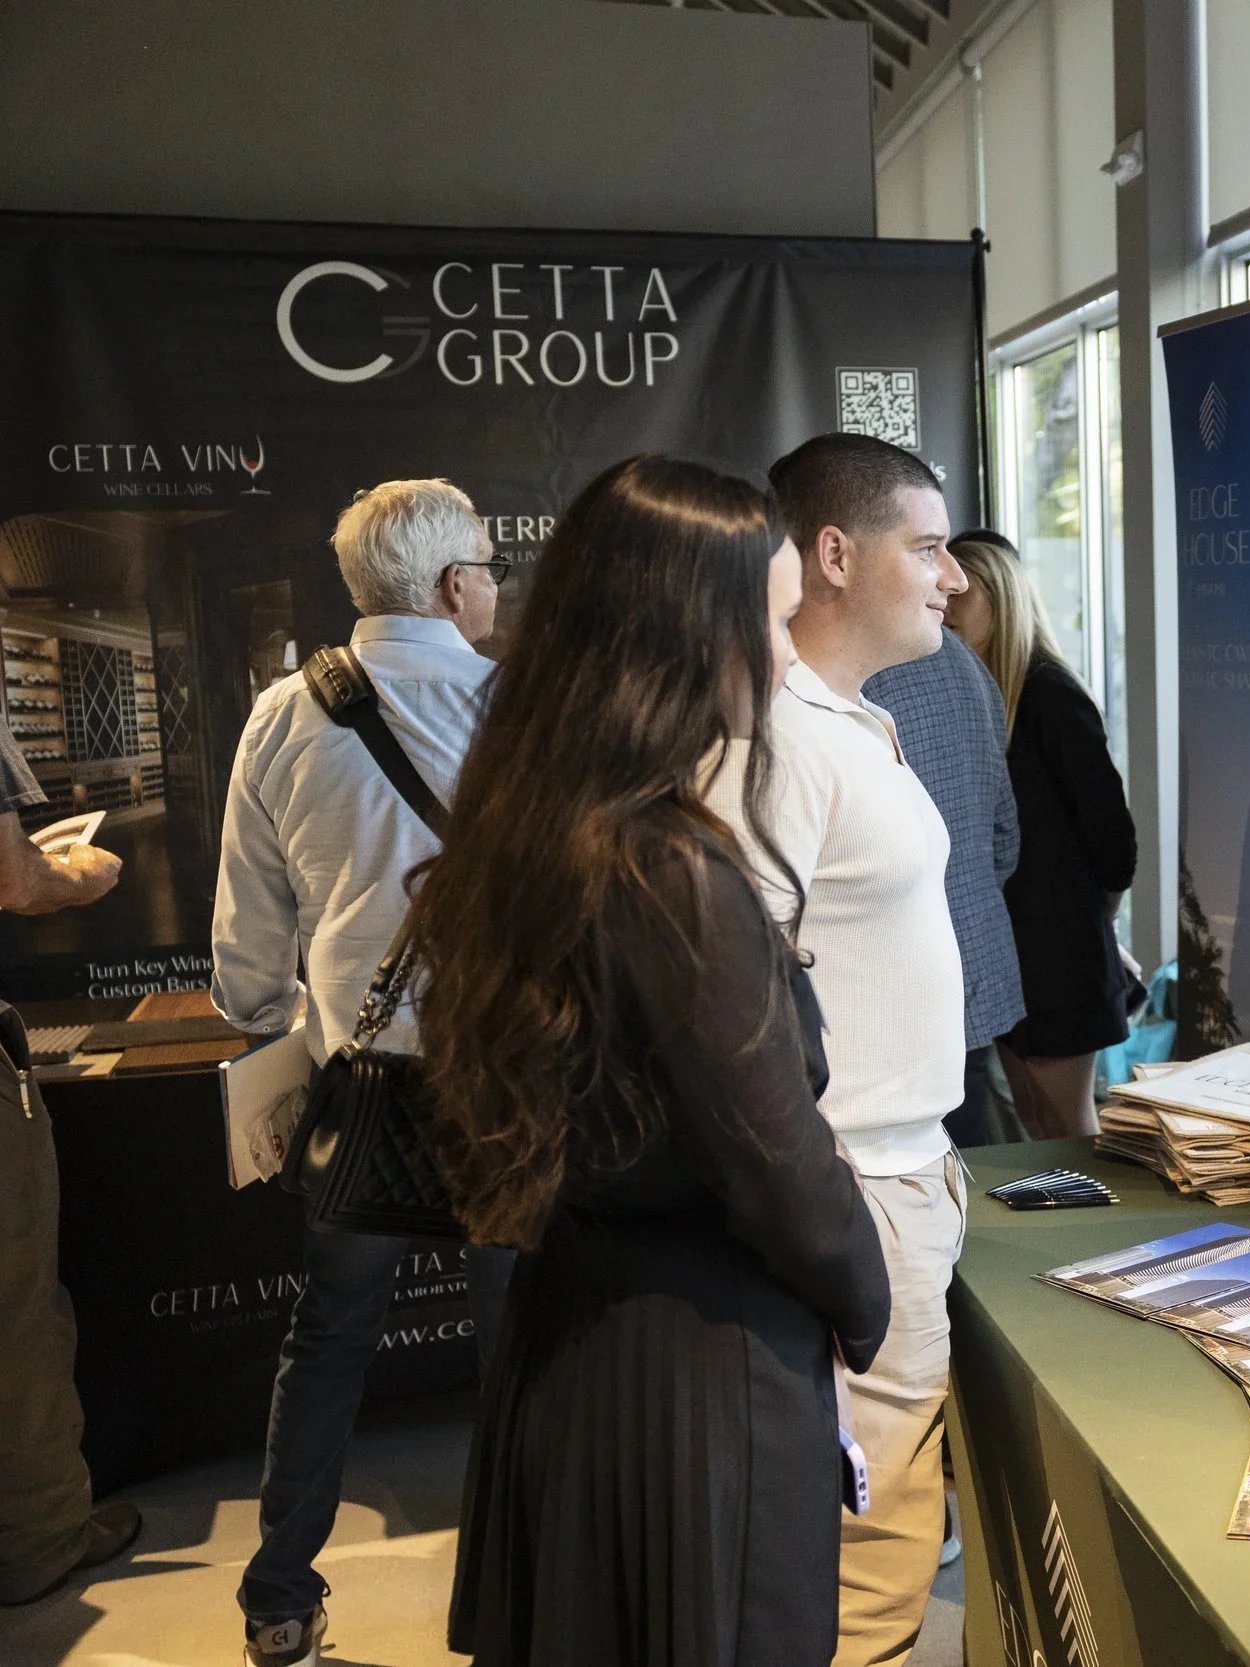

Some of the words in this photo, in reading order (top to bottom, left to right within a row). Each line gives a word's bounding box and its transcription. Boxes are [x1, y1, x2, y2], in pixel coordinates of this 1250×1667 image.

[433, 262, 677, 322] CETTA
[437, 329, 679, 386] GROUP
[48, 444, 161, 473] CETTA
[103, 483, 142, 496] WINE
[147, 482, 213, 496] CELLARS
[1189, 483, 1240, 521] EDGE
[1183, 530, 1250, 567] HOUSE
[86, 963, 130, 980] Turn
[134, 959, 167, 977] Key
[88, 983, 162, 1000] Custom
[167, 976, 208, 993] Bars
[151, 1283, 239, 1316] CETTA
[258, 1272, 309, 1300] VIN
